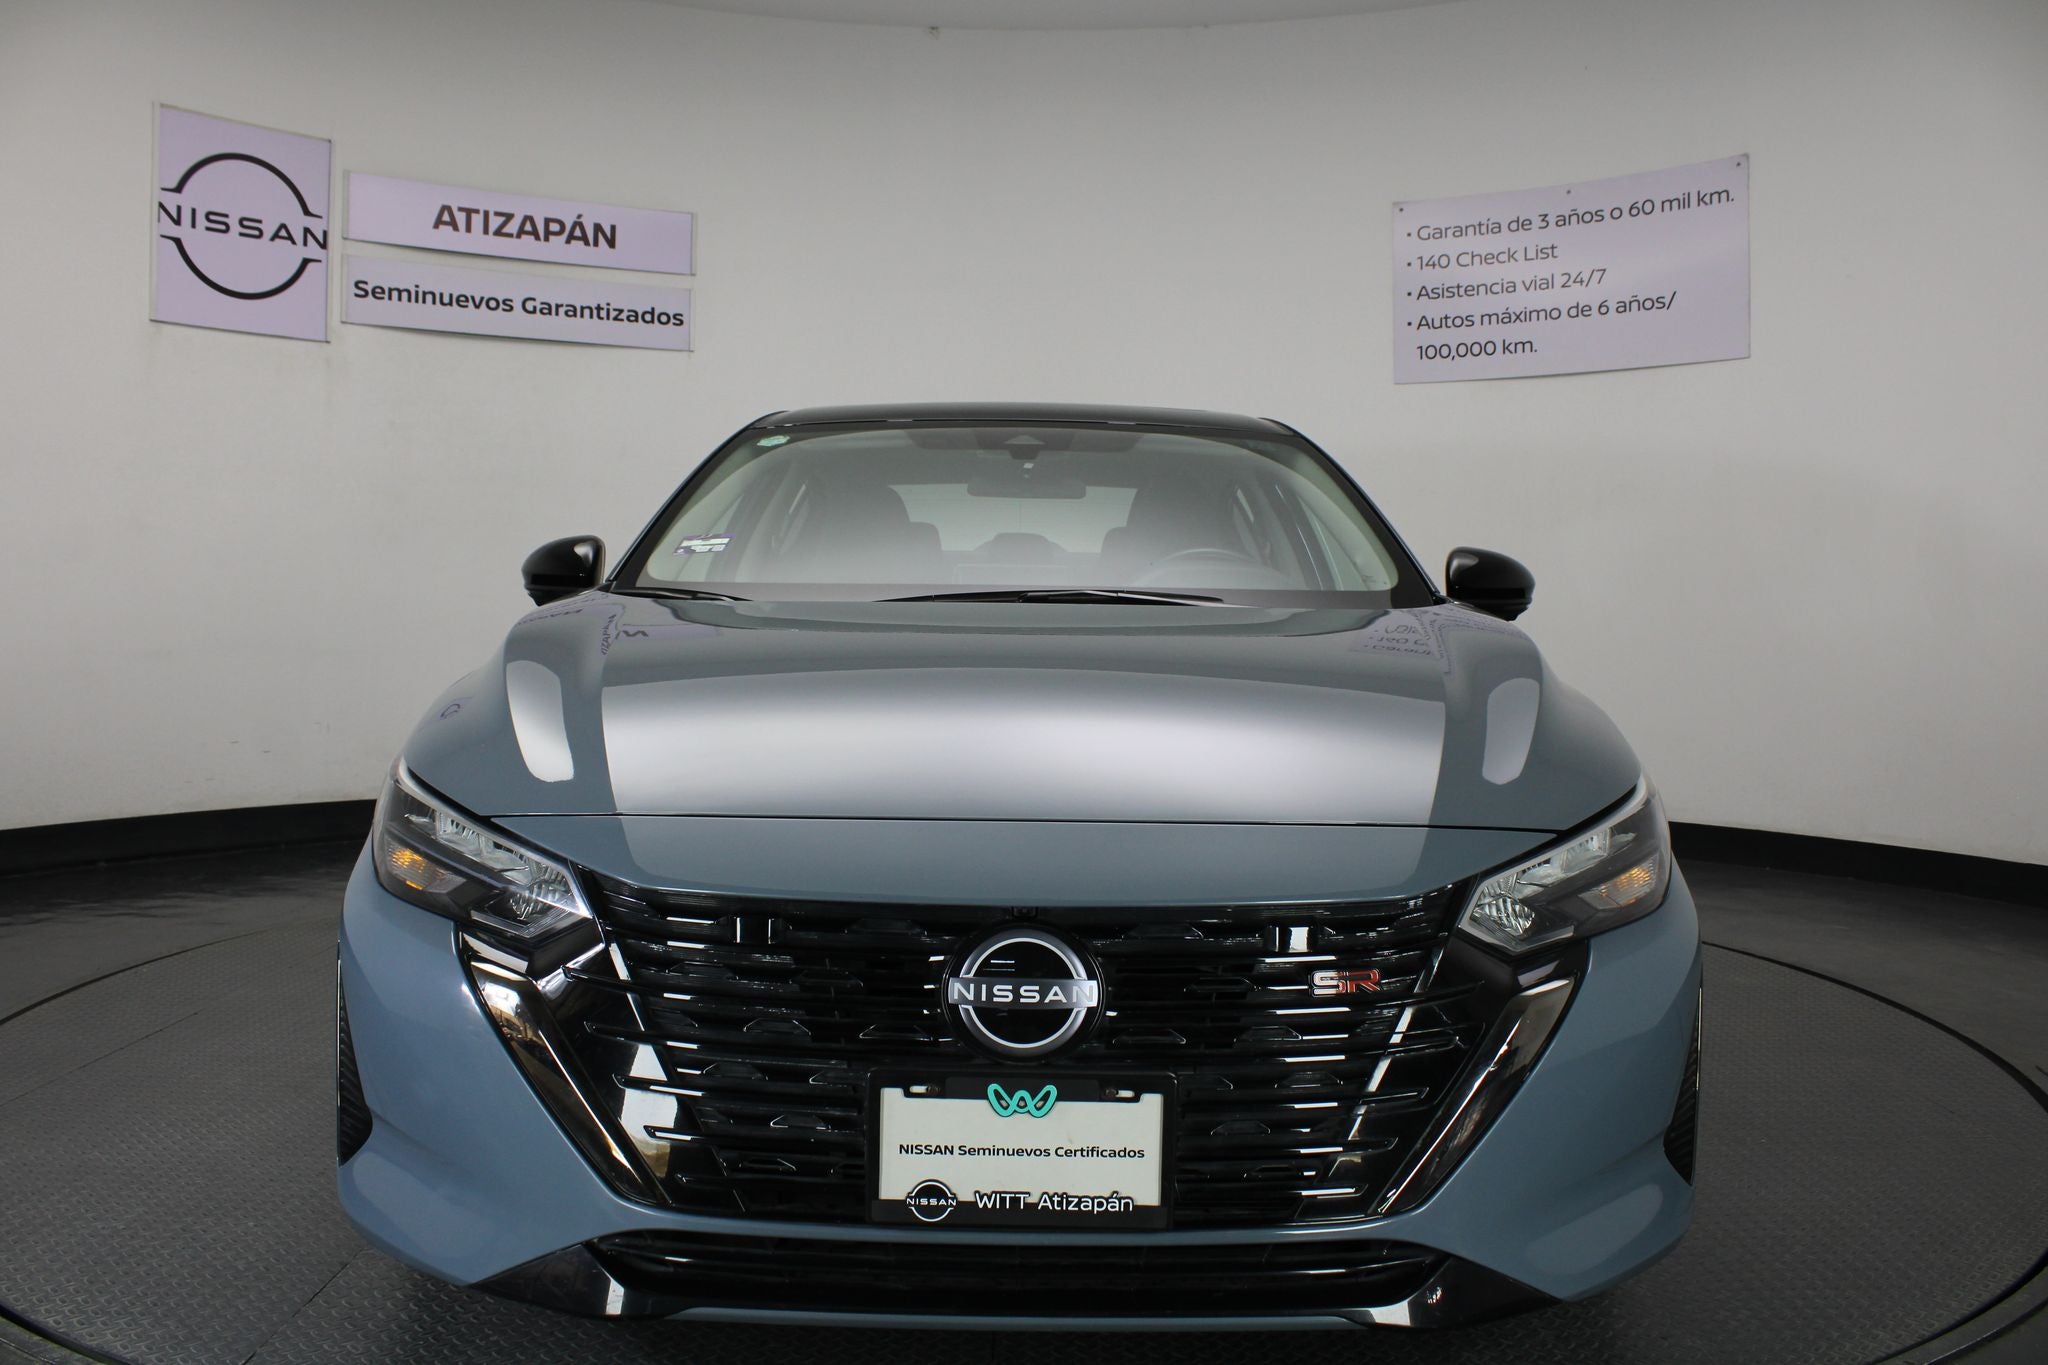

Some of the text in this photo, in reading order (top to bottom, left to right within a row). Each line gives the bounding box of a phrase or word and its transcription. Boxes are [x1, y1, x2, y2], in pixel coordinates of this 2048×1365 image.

[158, 200, 327, 251] NISSAN
[431, 203, 618, 250] ATIZAPÁN
[1416, 188, 1735, 241] Garantía de 3 años o 60 mil km.
[1416, 243, 1558, 271] 140 Check List
[1416, 268, 1607, 301] Asistencia vial 24/7
[353, 280, 685, 328] Seminuevos Garantizados
[1416, 291, 1677, 331] Autos máximo de 6 años/
[1416, 338, 1538, 361] 100,000 km.
[953, 982, 1094, 1004] NISSAN
[1312, 968, 1380, 996] SR
[899, 1144, 1145, 1159] NISSAN Seminuevos Certificados
[906, 1196, 957, 1206] NISSAN
[975, 1192, 1133, 1215] WITT Atizapán
